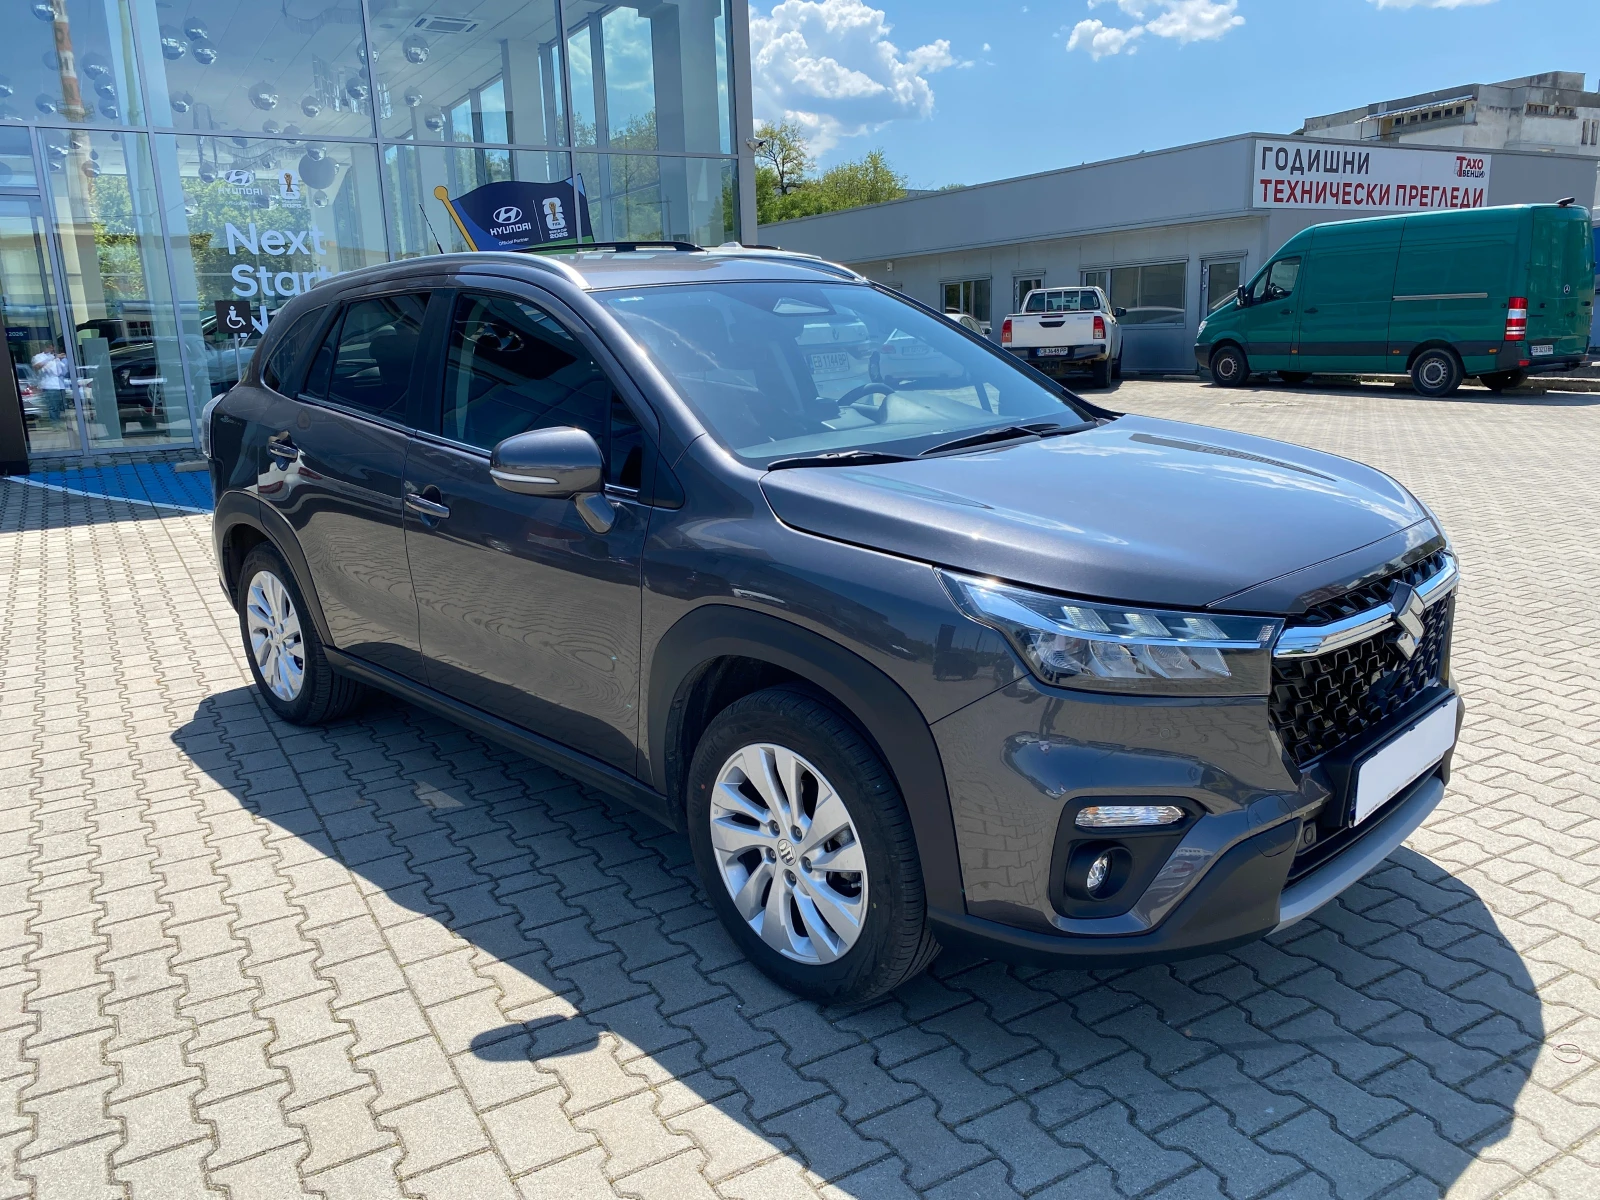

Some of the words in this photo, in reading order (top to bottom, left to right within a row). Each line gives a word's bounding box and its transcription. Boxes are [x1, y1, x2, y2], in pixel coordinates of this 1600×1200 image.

[1261, 147, 1370, 175] ГОДИШНИ
[1456, 156, 1484, 177] ТАХО
[217, 187, 263, 195] HYUNDAI
[1260, 179, 1391, 205] ТЕХНИЧЕСКИ
[1395, 184, 1484, 209] ПРЕГЛЕДИ
[225, 223, 326, 255] Next
[490, 222, 532, 236] HYUNDAI
[231, 264, 346, 297] Start
